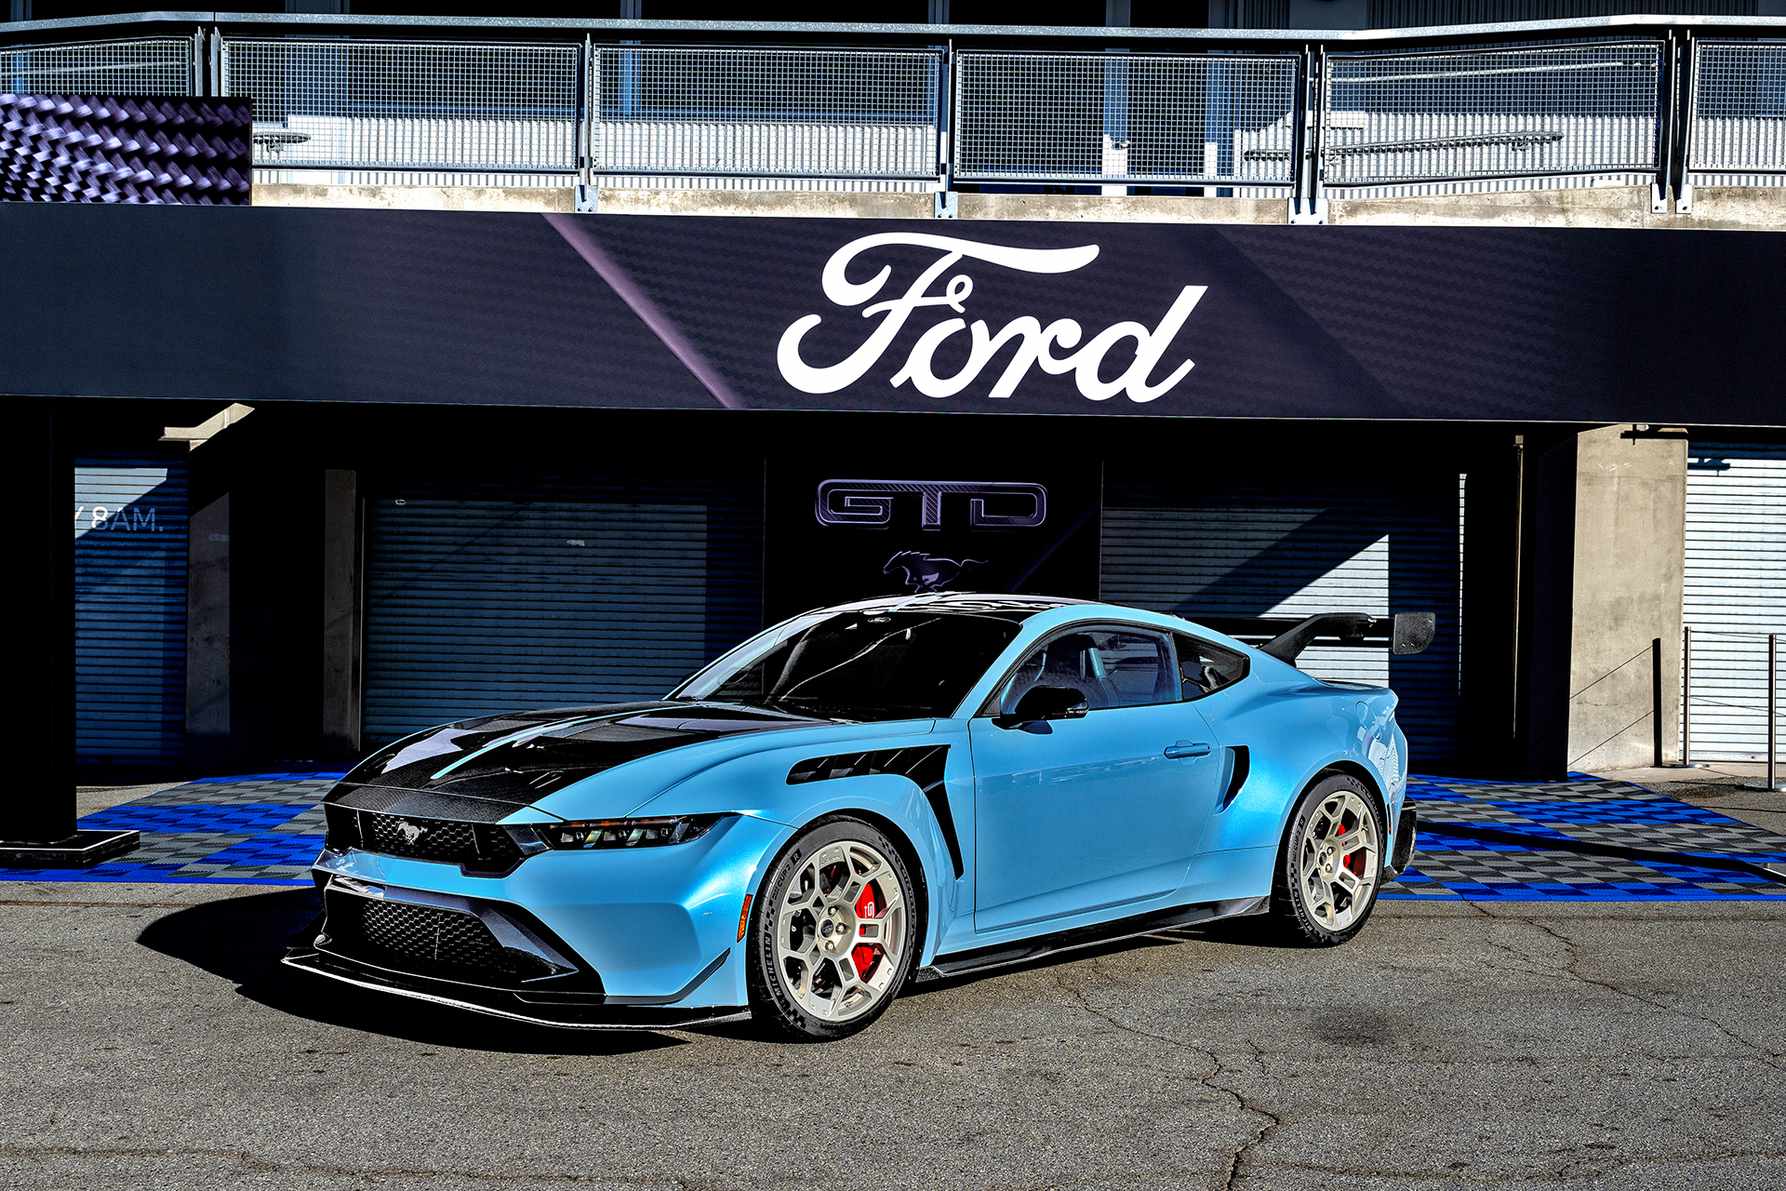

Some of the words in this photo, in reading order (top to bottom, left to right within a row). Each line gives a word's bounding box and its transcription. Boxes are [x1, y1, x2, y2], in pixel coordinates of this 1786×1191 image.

[777, 232, 1208, 402] Ford
[91, 505, 164, 532] 8AM.
[815, 479, 1048, 530] GTD
[765, 935, 781, 996] MICHELIN
